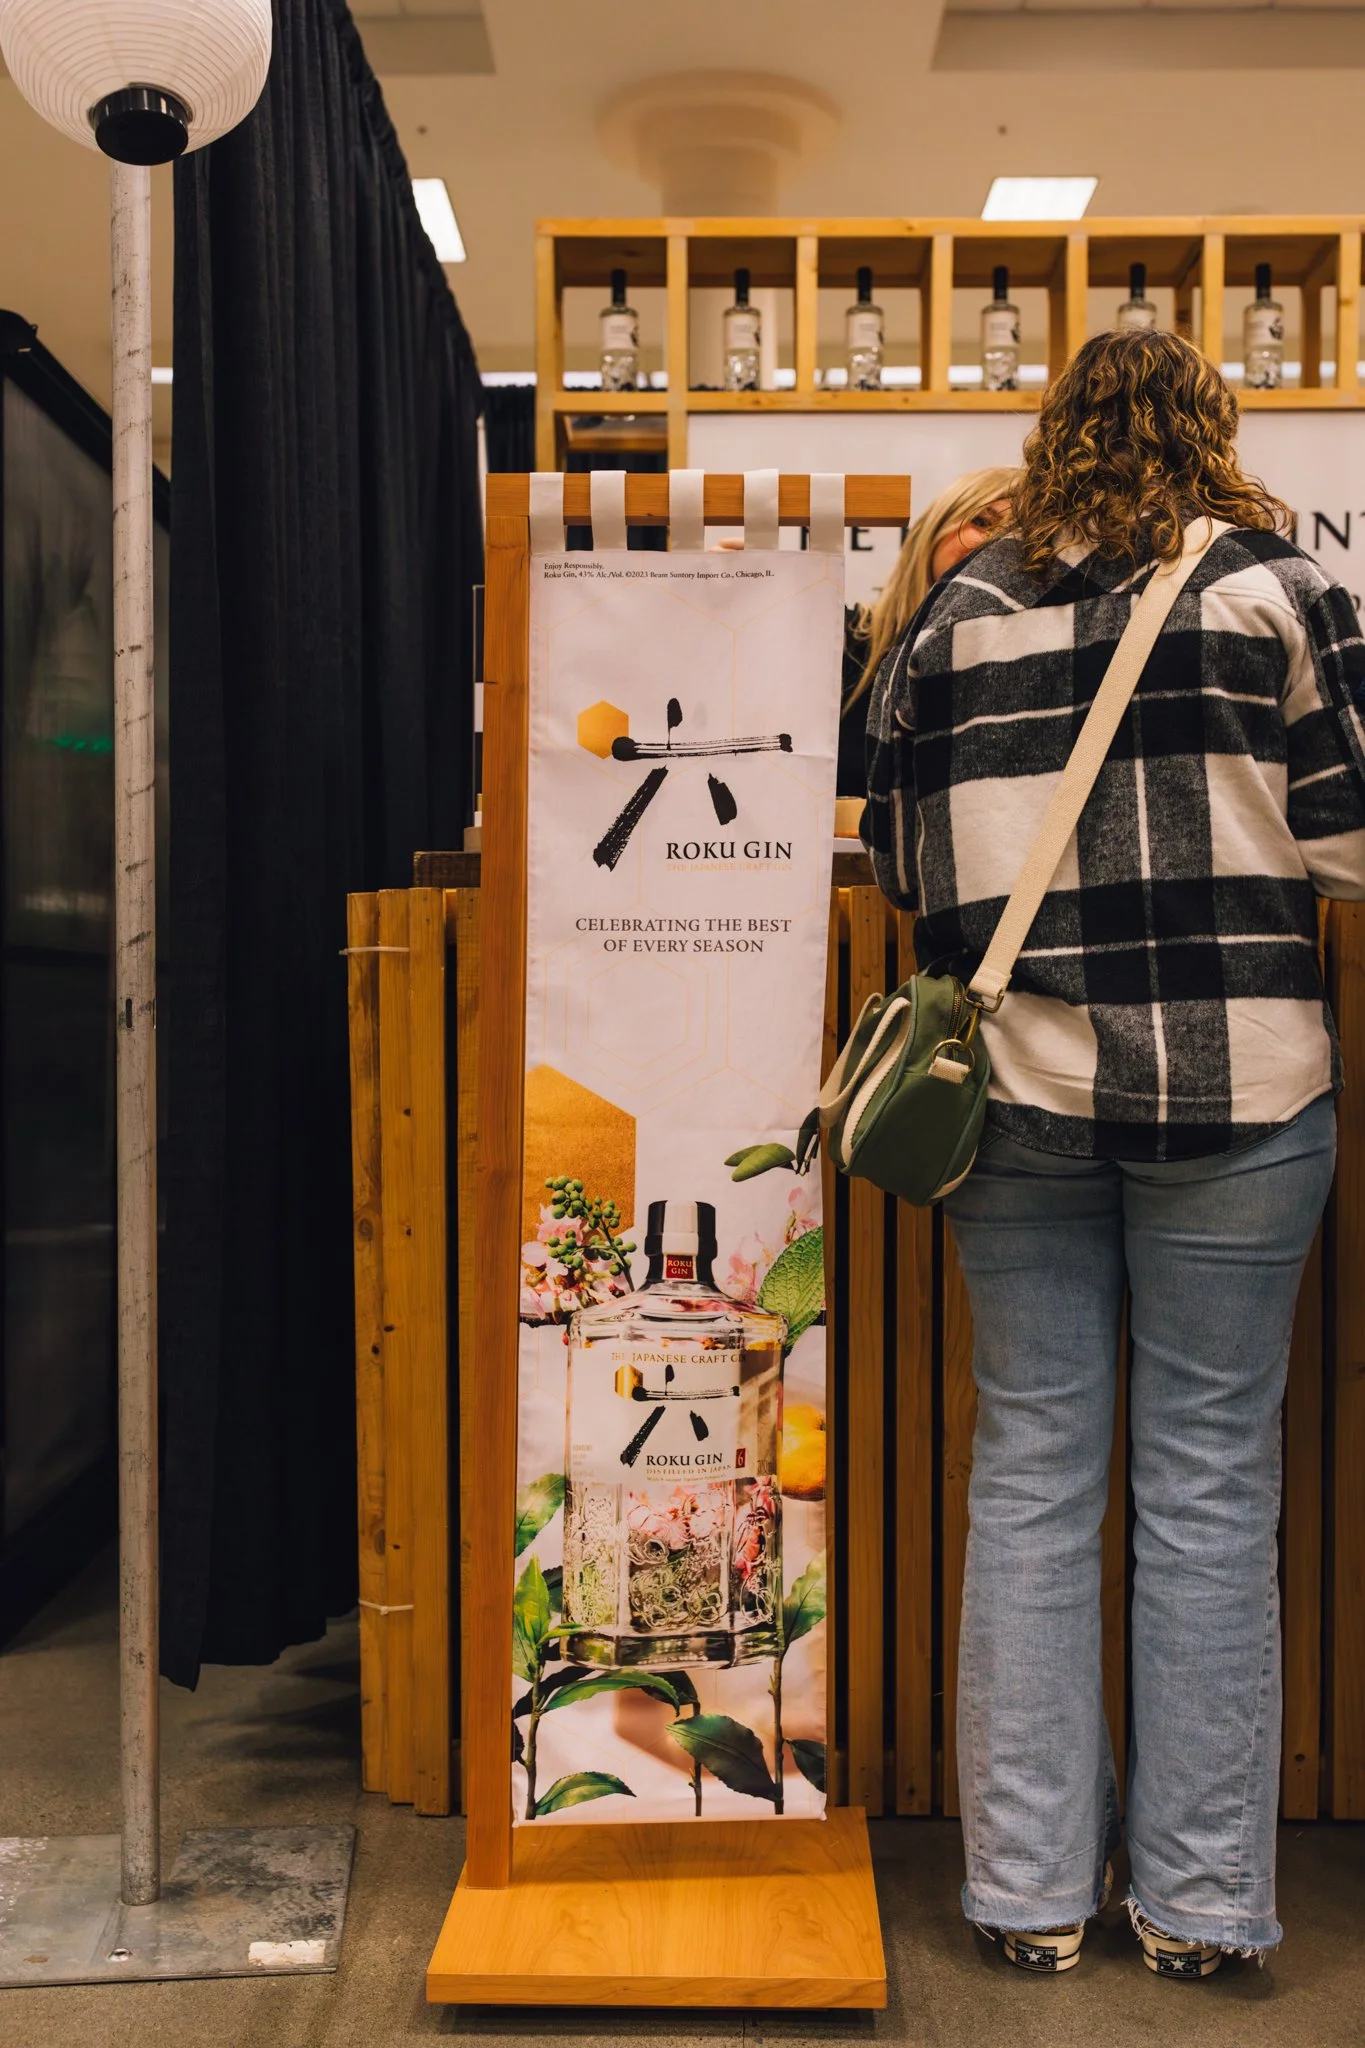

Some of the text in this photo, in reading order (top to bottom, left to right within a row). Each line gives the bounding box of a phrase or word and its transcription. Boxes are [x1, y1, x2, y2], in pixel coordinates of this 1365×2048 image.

[544, 562, 604, 570] Enjoy Responsibly.
[544, 571, 561, 579] Roku
[563, 571, 577, 579] Gin,
[670, 571, 695, 579] Suntory
[697, 572, 719, 580] Import
[735, 570, 764, 579] Chicago,
[665, 840, 793, 860] ROKU GIN
[575, 918, 792, 933] CELEBRATING THE BEST
[603, 939, 764, 953] OF EVERY SEASON
[667, 1259, 692, 1268] ROKU
[671, 1267, 688, 1275] GIN
[632, 1352, 687, 1364] JAPANESE
[691, 1353, 728, 1364] CRAFT
[646, 1452, 723, 1466] ROKU GIN
